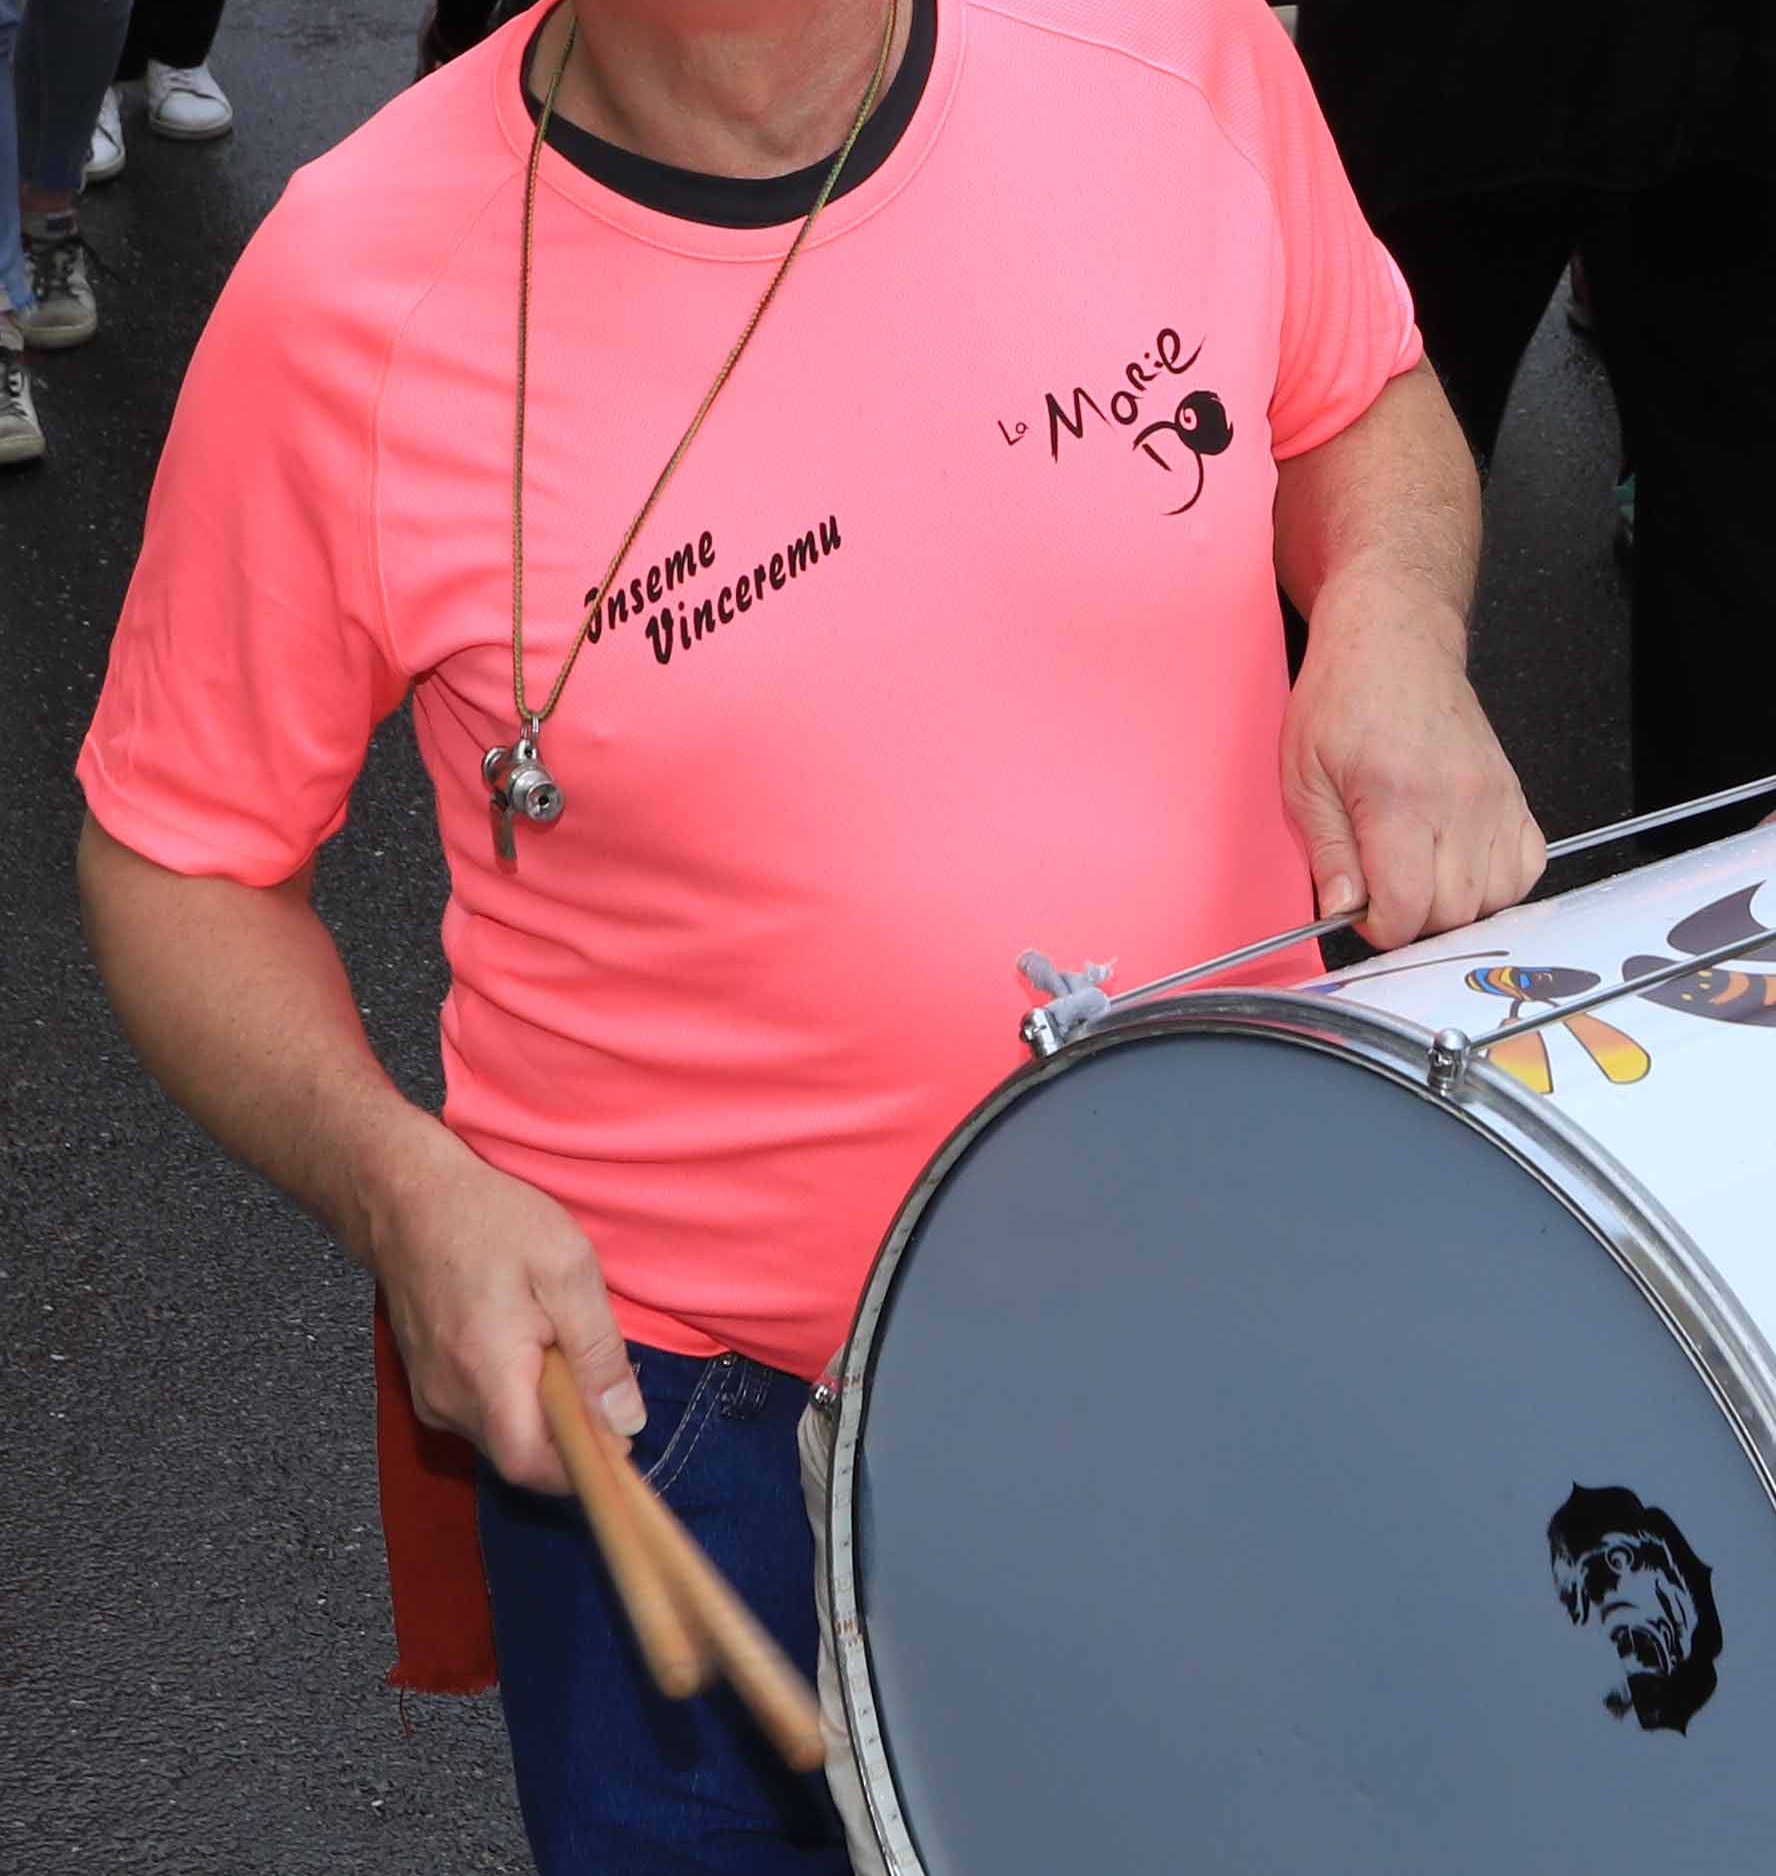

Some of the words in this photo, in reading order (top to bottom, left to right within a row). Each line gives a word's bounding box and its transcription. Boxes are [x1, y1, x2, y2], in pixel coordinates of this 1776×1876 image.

[997, 420, 1029, 447] La
[584, 530, 716, 644] Inseme
[645, 514, 842, 665] Vinceremu
